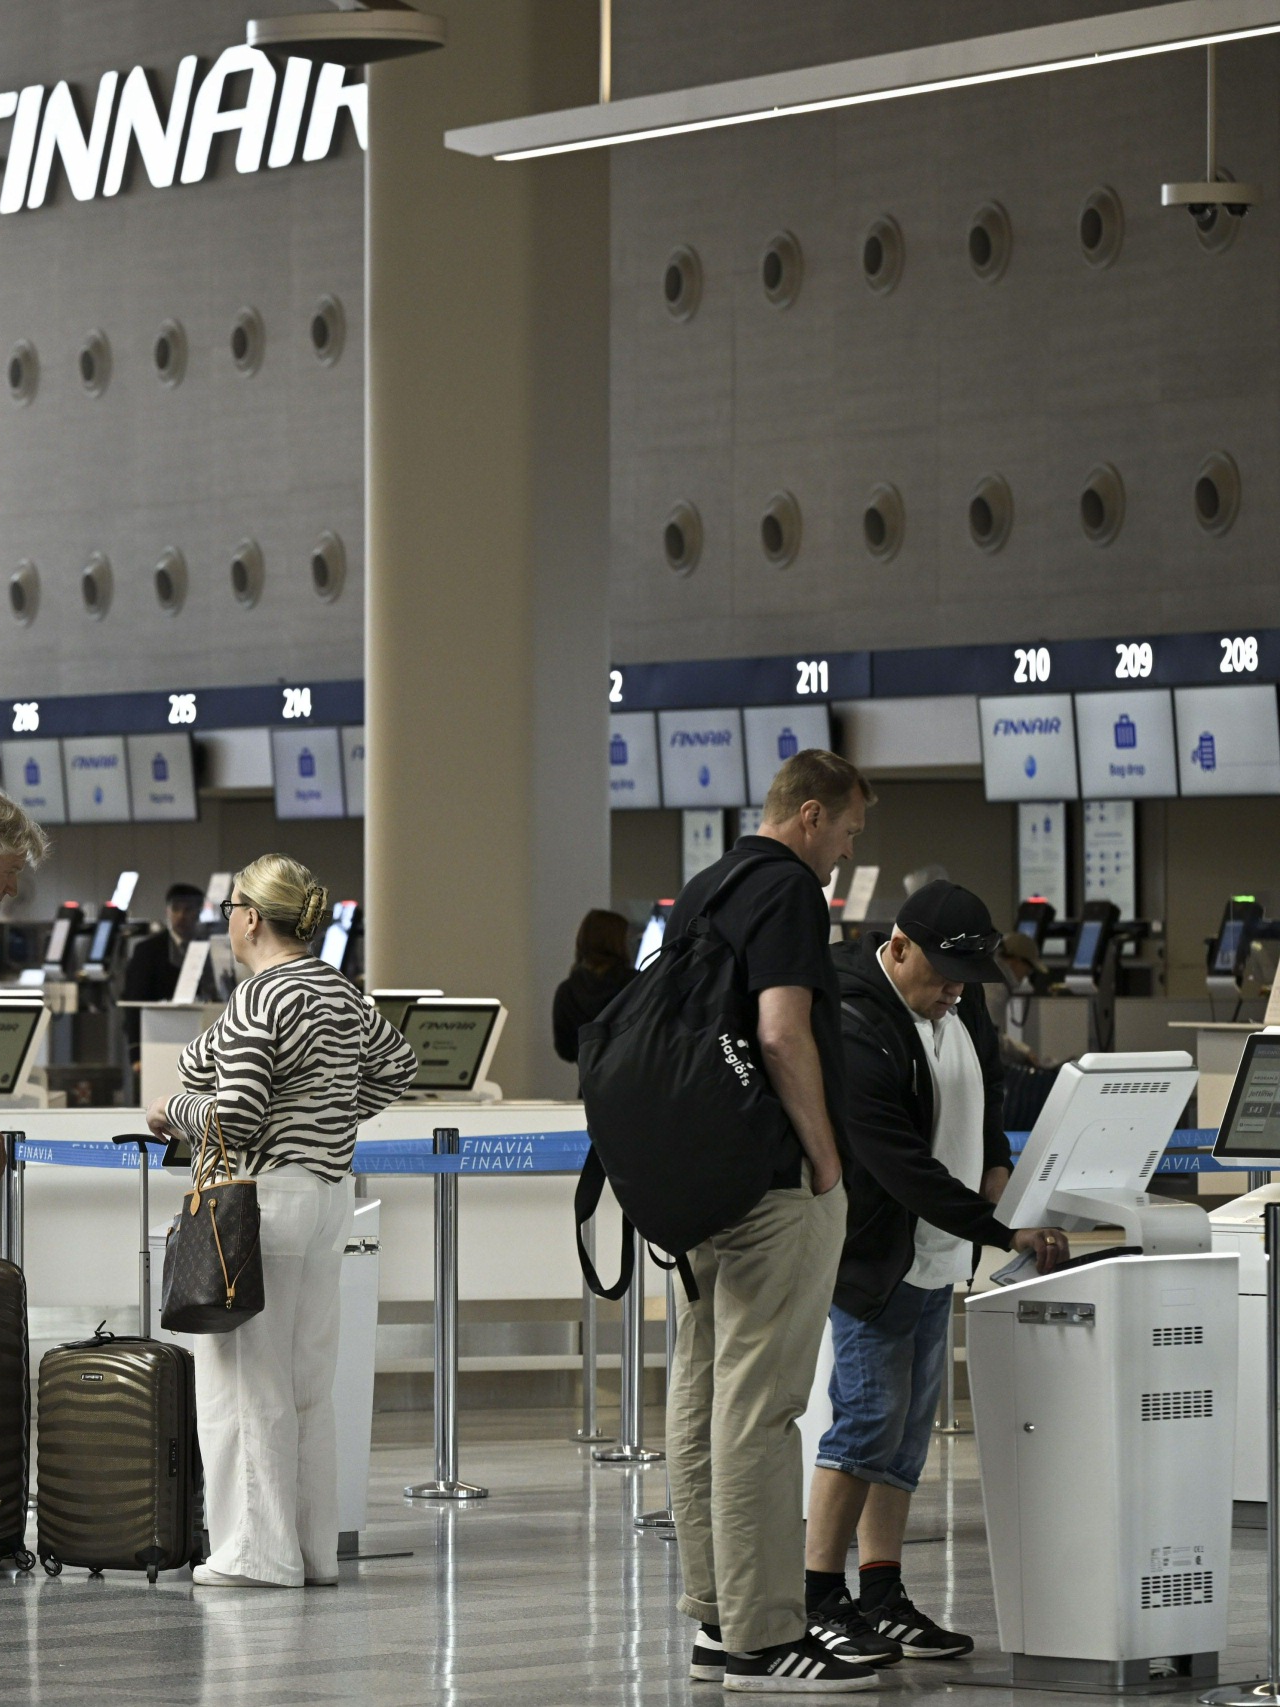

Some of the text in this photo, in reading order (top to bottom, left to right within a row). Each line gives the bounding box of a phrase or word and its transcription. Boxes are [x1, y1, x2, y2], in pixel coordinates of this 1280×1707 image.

[1014, 647, 1050, 683] 210
[1115, 643, 1152, 678] 209
[1220, 636, 1258, 673] 208
[795, 660, 828, 694] 211
[12, 702, 39, 732] 216
[168, 693, 196, 724] 215
[282, 687, 312, 718] 214
[671, 730, 732, 748] FINNAIR
[993, 717, 1061, 736] FINNAIR
[719, 1033, 750, 1086] Haglöfs
[18, 1145, 53, 1160] FINAVIA
[463, 1140, 533, 1154] FINAVIA
[460, 1155, 534, 1170] FINAVIA
[1161, 1157, 1200, 1170] AVIA
[767, 1657, 782, 1673] adidas
